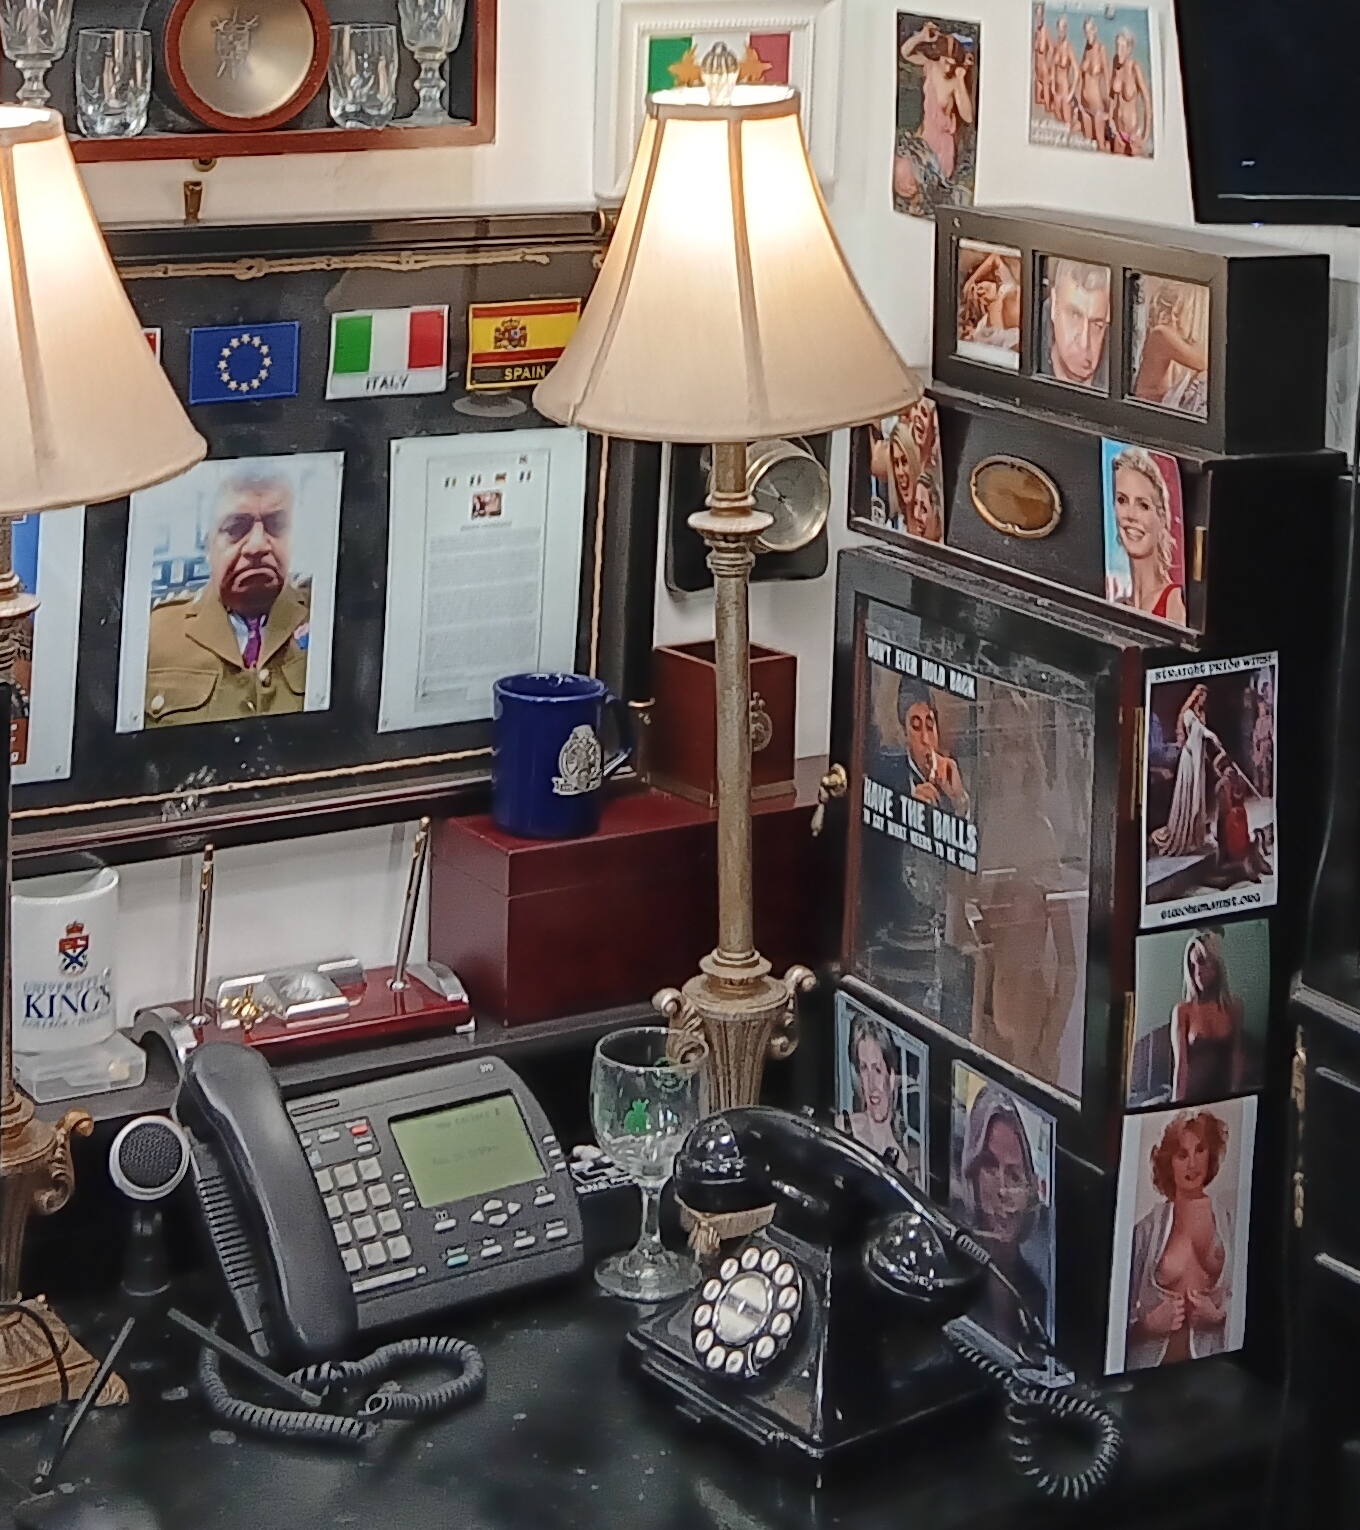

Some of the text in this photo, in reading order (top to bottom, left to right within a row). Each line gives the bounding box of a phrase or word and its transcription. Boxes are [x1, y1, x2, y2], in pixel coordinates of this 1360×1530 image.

[366, 373, 410, 392] ITALY
[504, 364, 546, 382] SPAIN
[863, 776, 978, 854] HAVE THE BALLS
